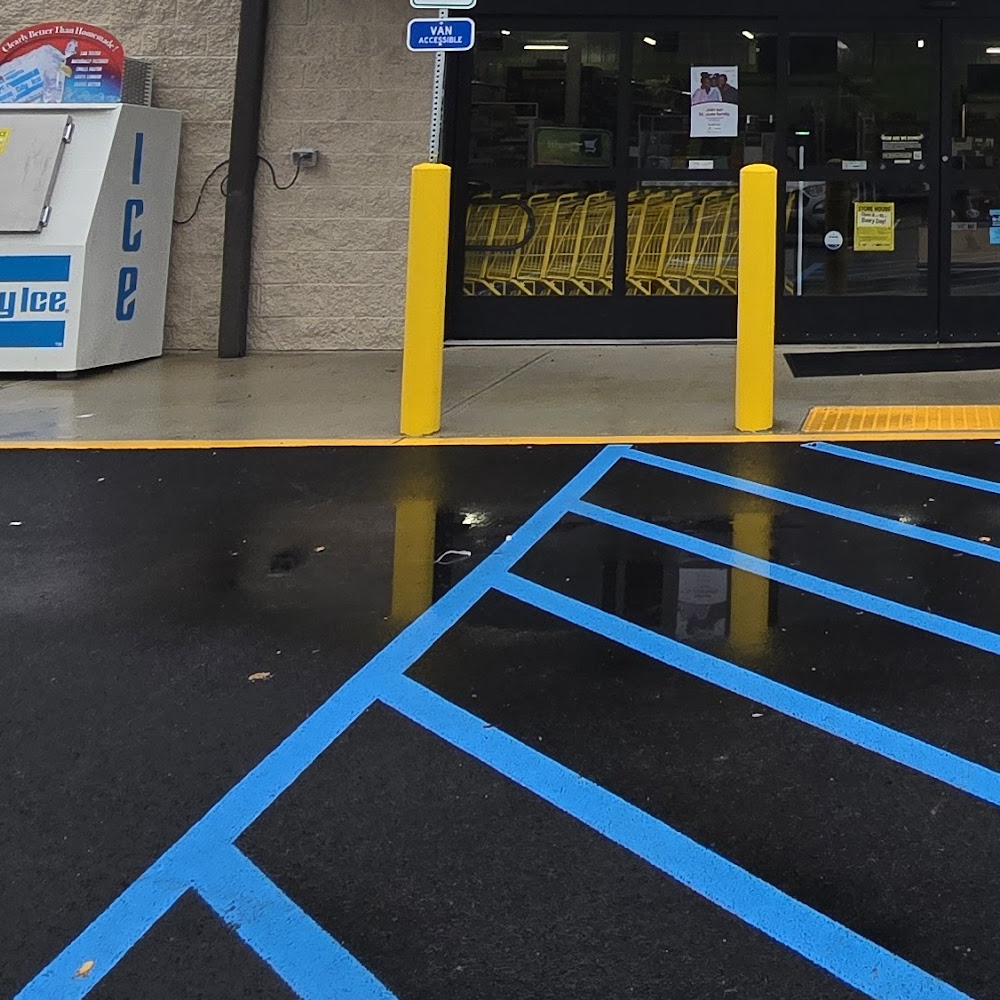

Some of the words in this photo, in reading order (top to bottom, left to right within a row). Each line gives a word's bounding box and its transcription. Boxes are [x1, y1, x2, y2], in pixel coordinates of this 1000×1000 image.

[28, 29, 53, 39] Better
[55, 26, 74, 34] Than
[430, 26, 452, 36] VAN
[418, 36, 463, 45] ACCESSIBLE
[20, 287, 67, 313] Ice
